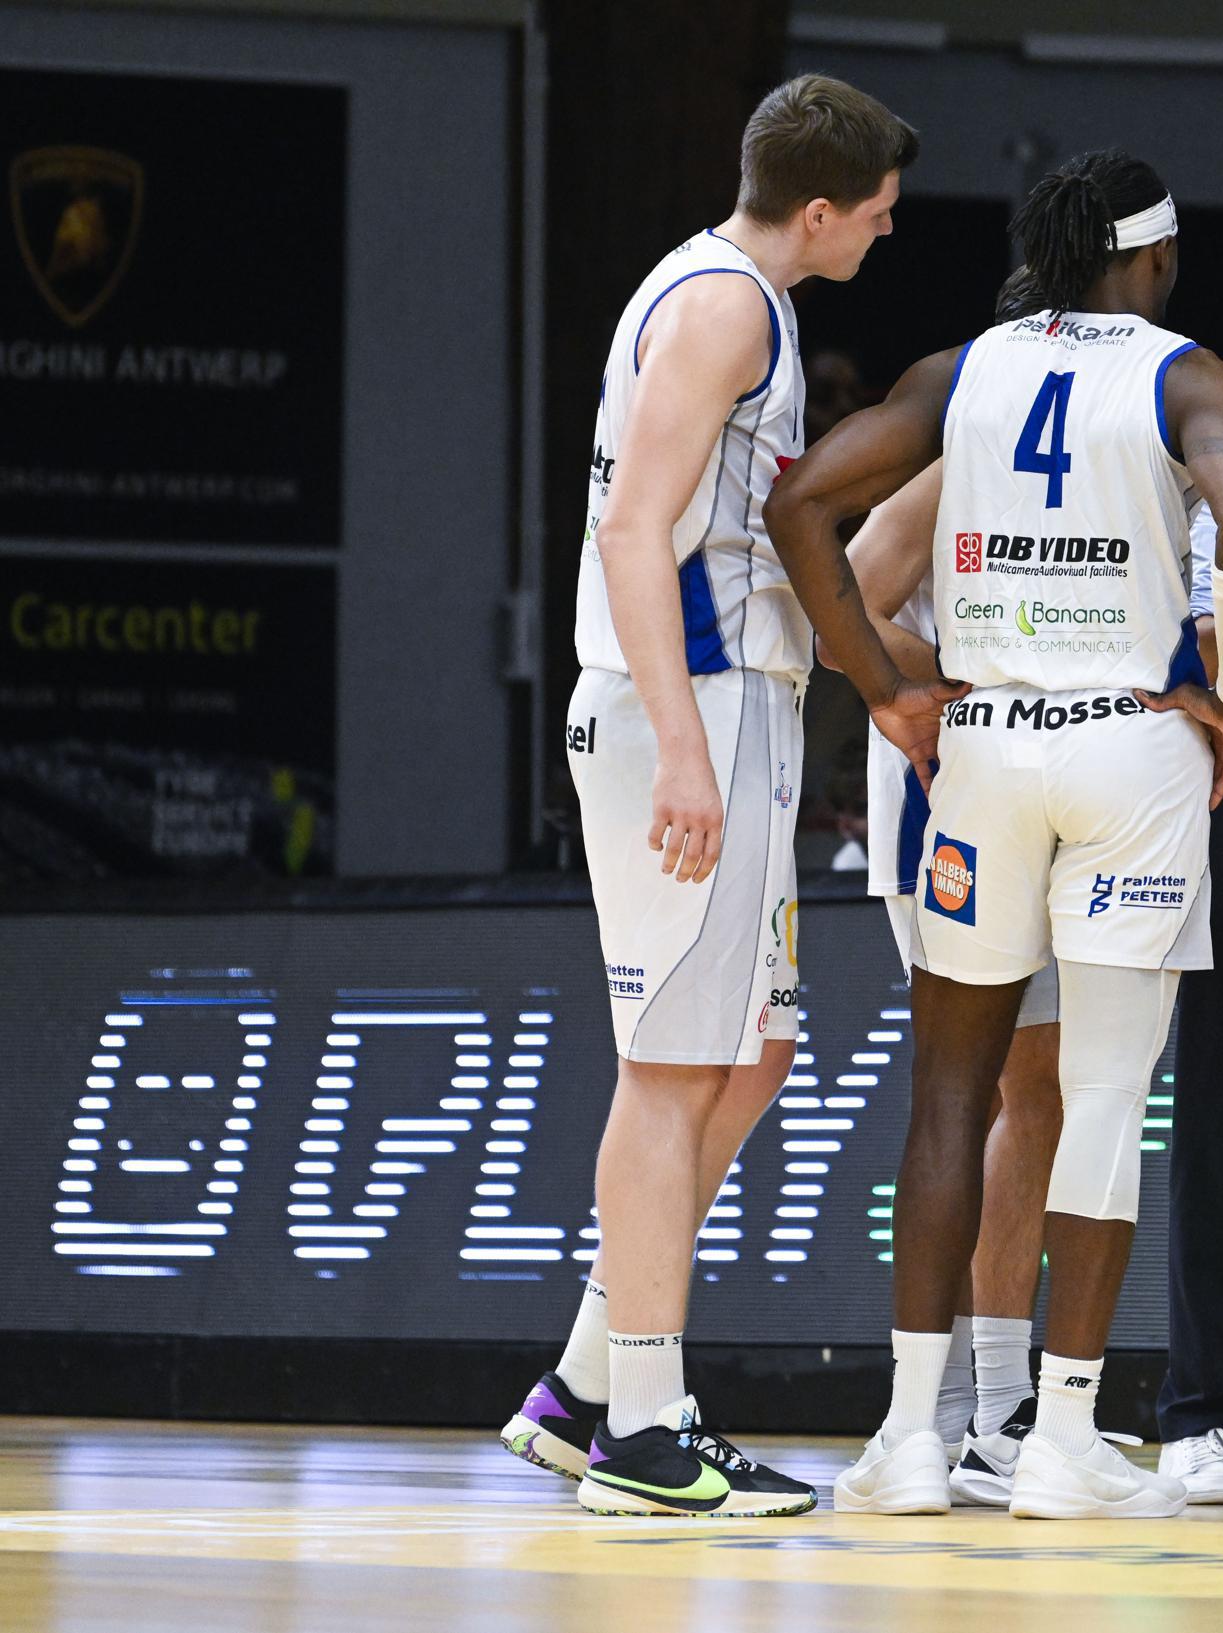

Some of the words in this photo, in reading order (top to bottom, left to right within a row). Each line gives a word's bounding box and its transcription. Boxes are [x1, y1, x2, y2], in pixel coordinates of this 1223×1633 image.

[113, 344, 289, 389] ANTWERP
[1013, 370, 1076, 509] 4
[986, 534, 1036, 561] DB
[1039, 537, 1130, 564] VIDEO
[10, 590, 262, 656] Carcenter
[955, 597, 1004, 620] Green
[1032, 601, 1126, 624] Bananas
[955, 636, 1010, 649] MARKETING
[1028, 640, 1132, 653] COMMUNICATIE
[934, 873, 965, 899] IMMO
[1122, 876, 1186, 887] Palletten
[1120, 891, 1184, 903] PEETERS
